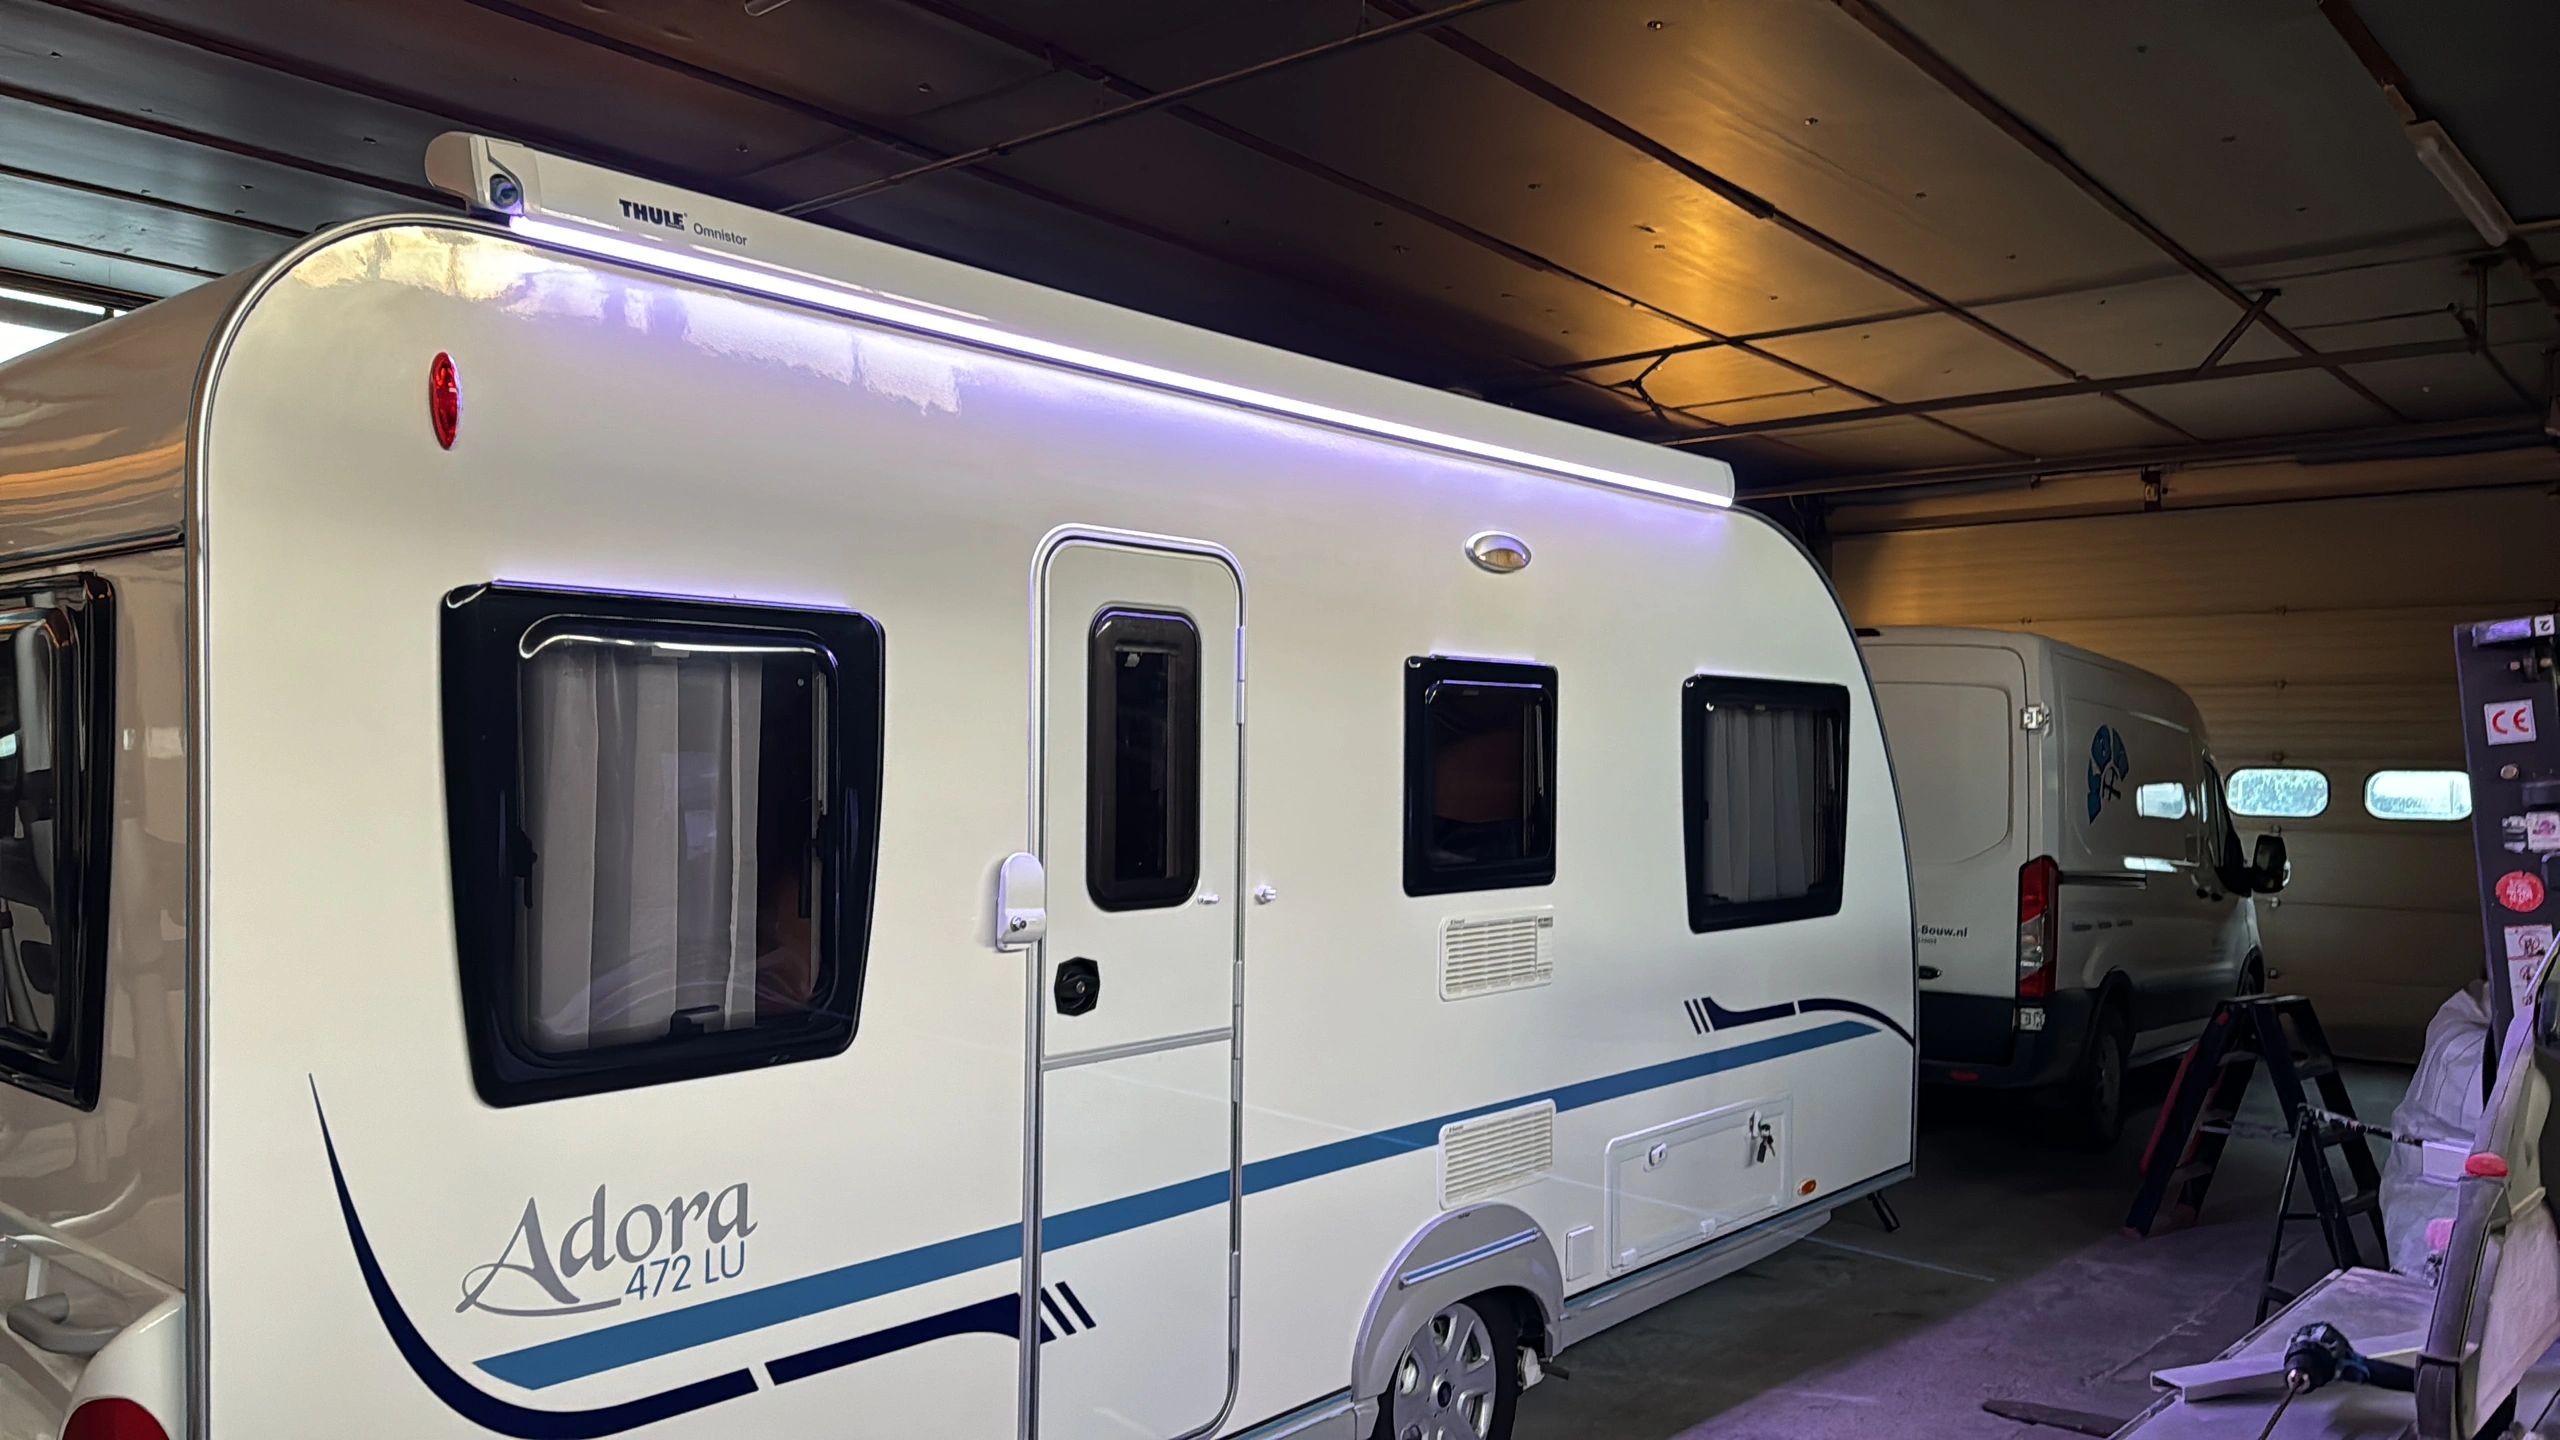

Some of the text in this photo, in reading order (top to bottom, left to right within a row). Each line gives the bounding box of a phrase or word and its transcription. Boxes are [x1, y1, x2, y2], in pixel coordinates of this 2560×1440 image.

[619, 198, 748, 246] THULE Omnistor
[2492, 707, 2530, 735] CE
[455, 1182, 758, 1316] Adora
[624, 1240, 745, 1300] 472 LU
